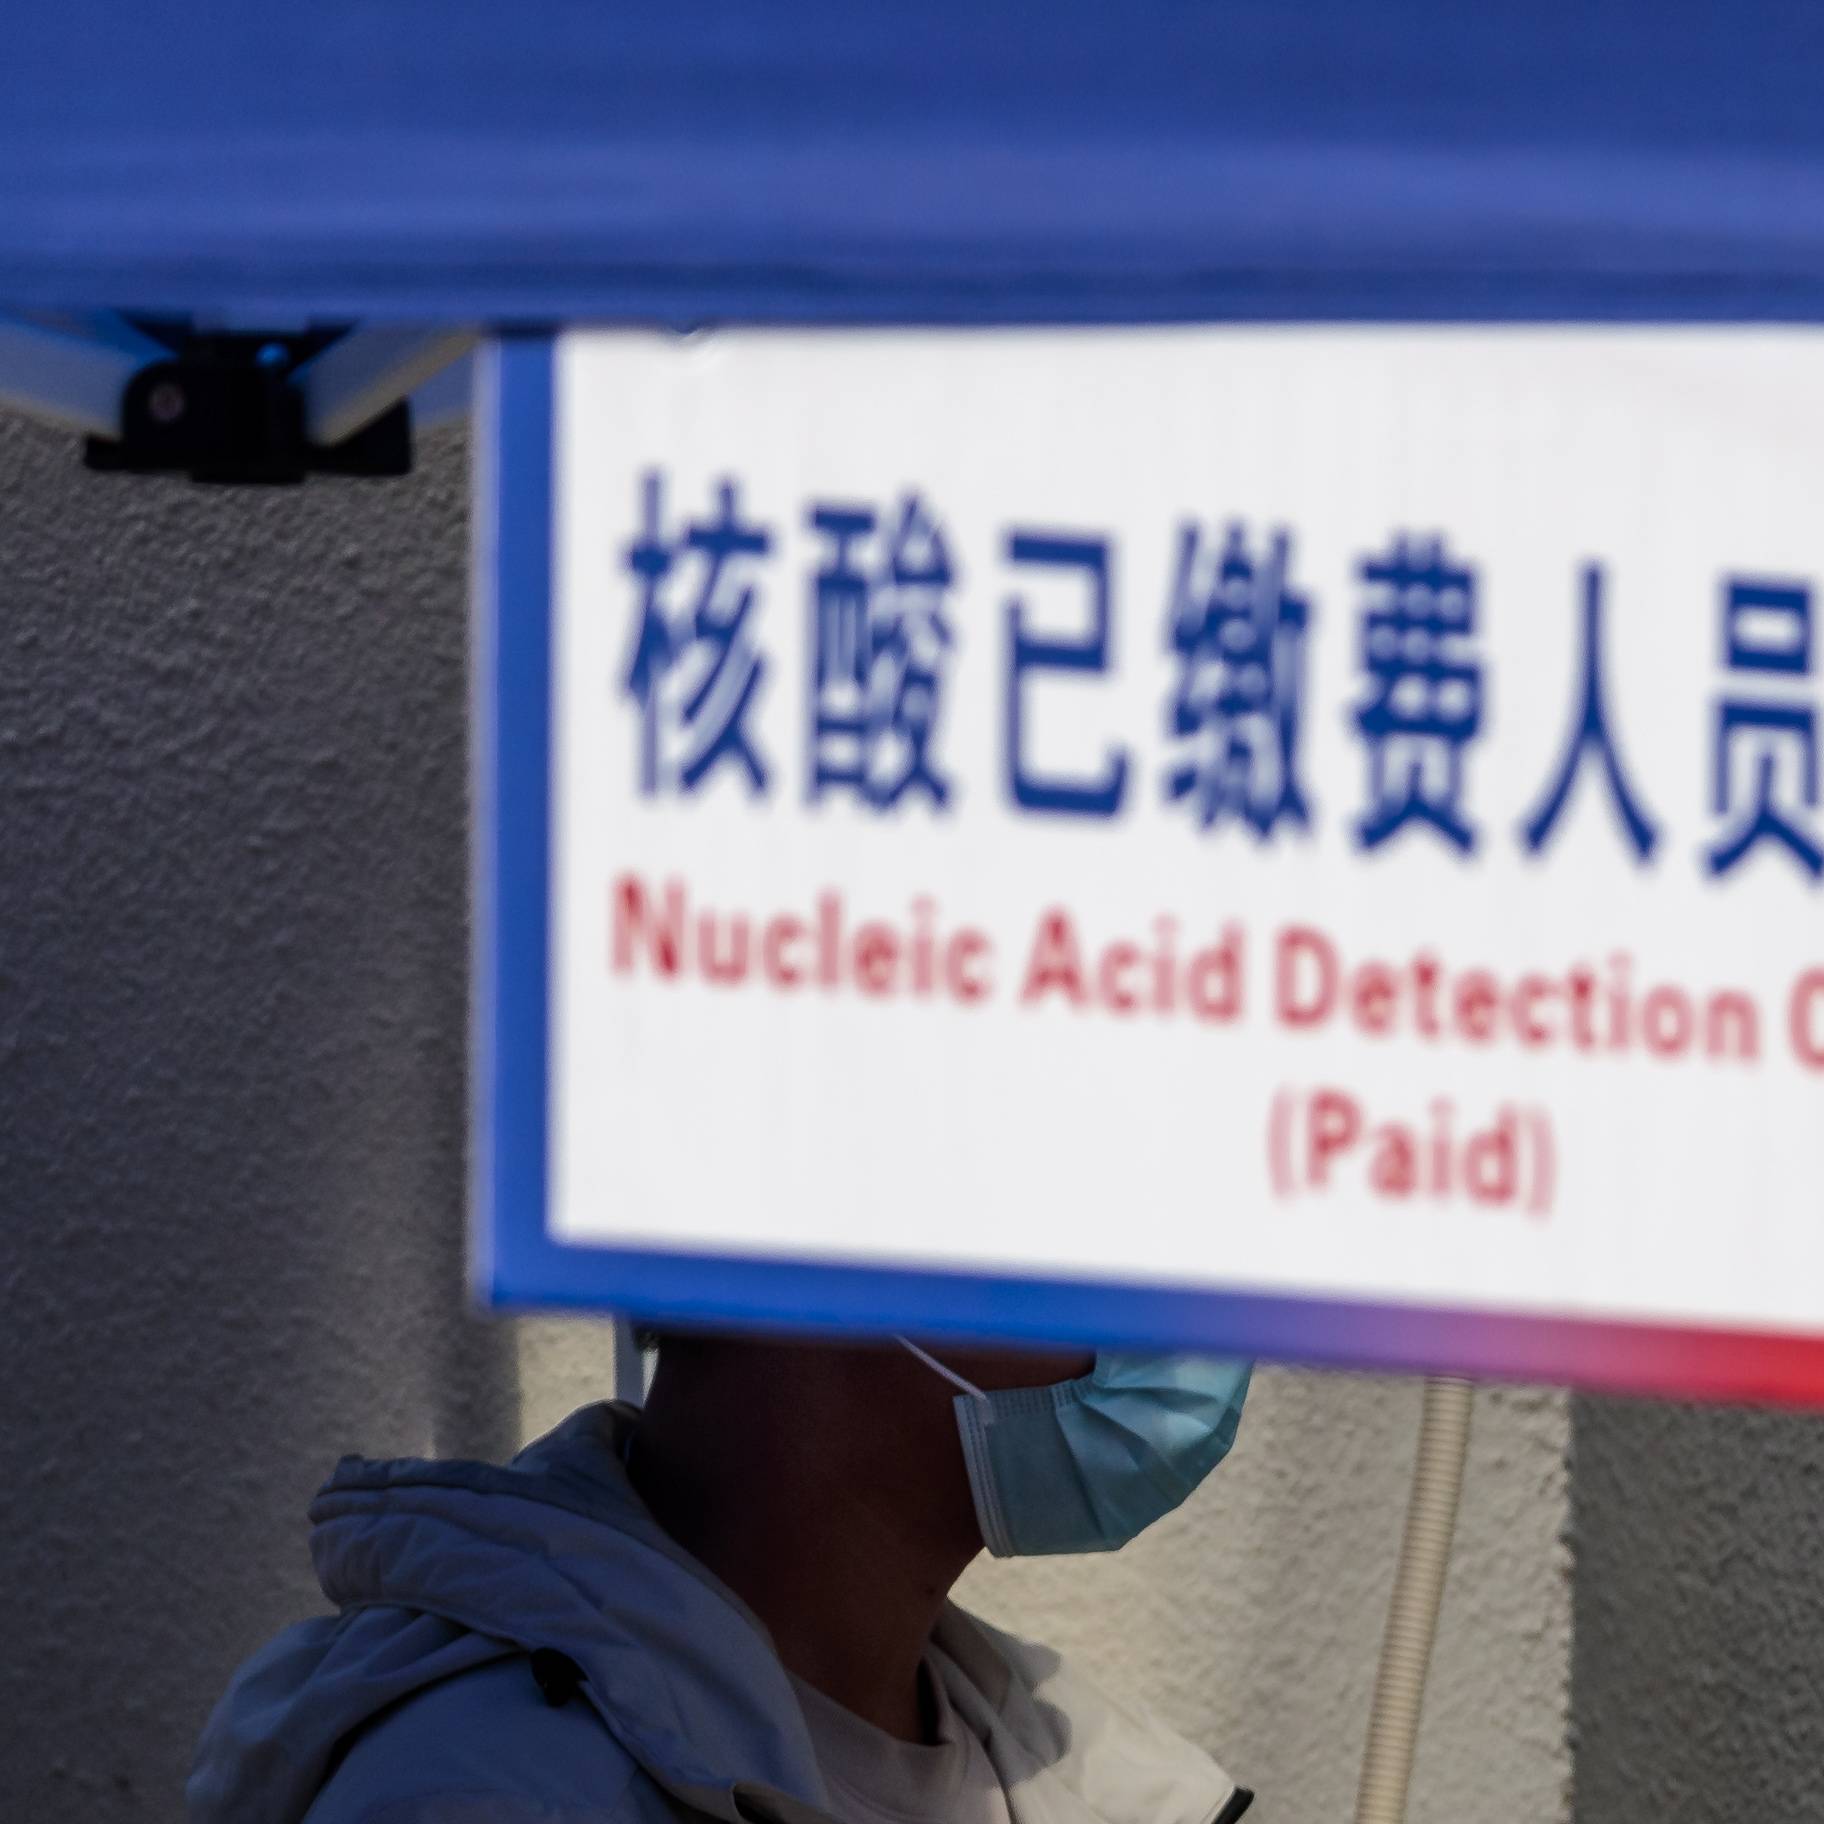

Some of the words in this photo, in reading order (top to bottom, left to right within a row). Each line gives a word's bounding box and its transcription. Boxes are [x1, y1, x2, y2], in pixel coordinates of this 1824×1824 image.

[613, 876, 993, 1004] Nucleic
[1023, 910, 1242, 1028] Acid
[1277, 926, 1759, 1065] Detection
[1268, 1091, 1557, 1217] (Paid)
